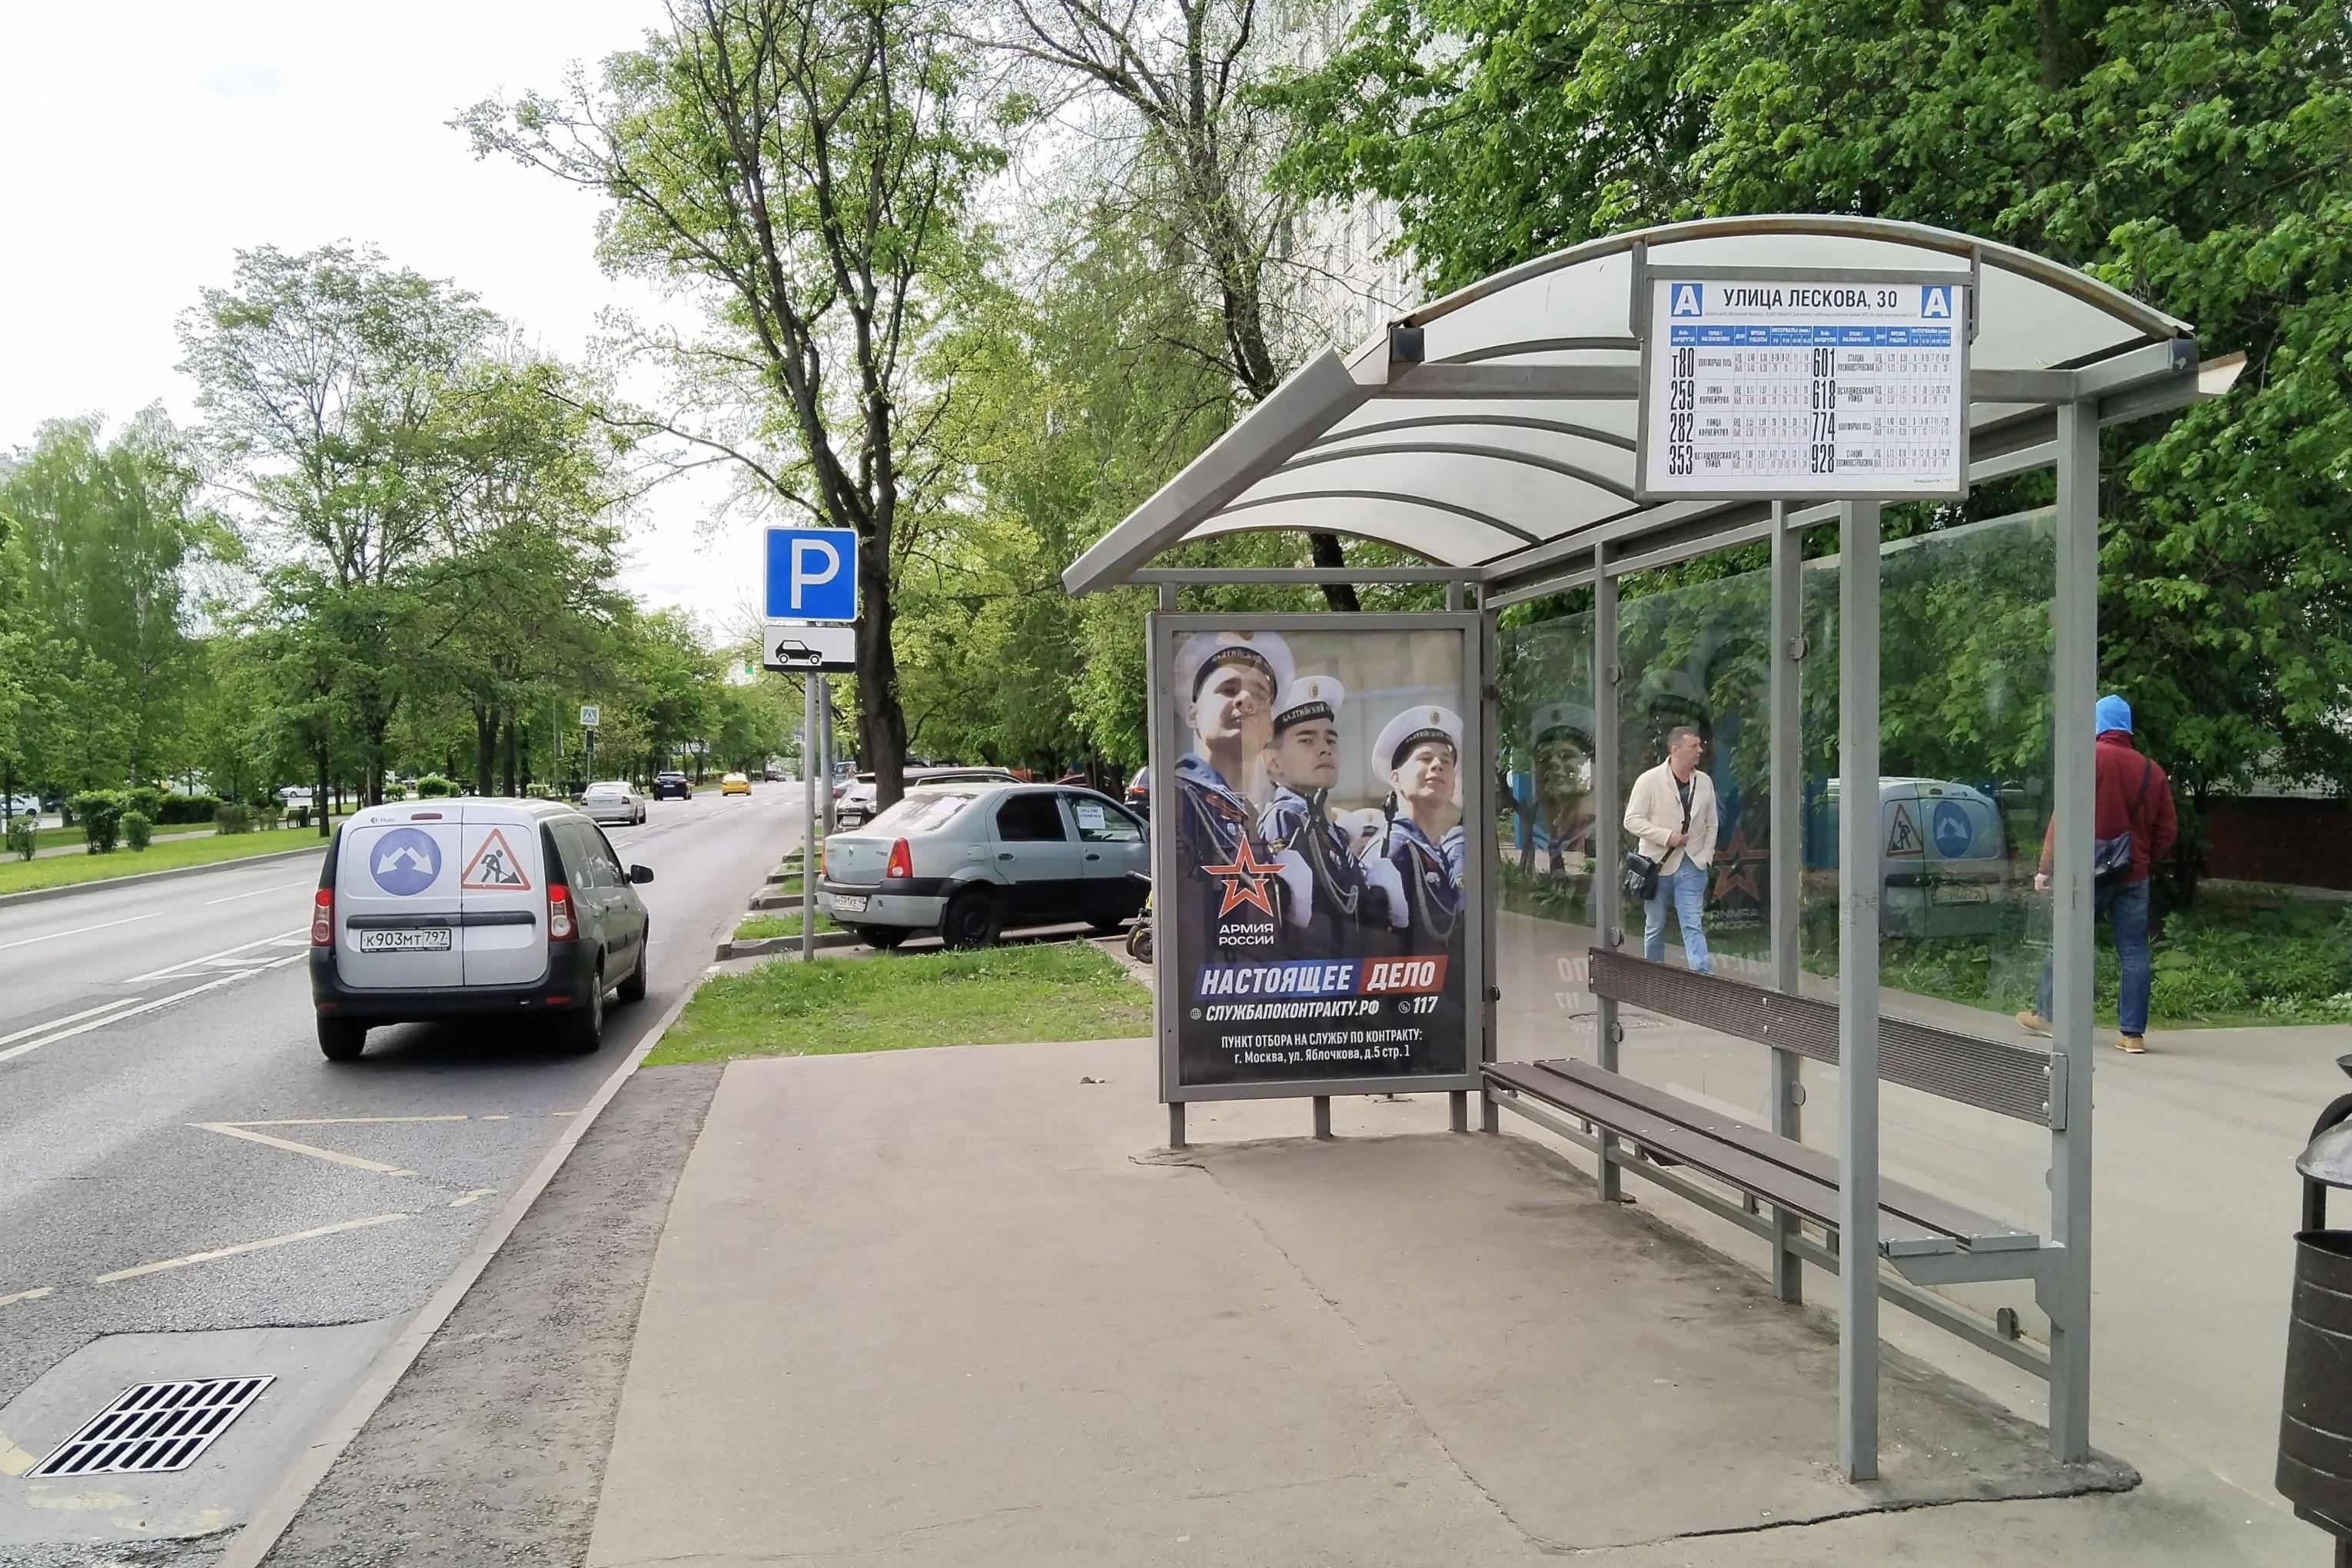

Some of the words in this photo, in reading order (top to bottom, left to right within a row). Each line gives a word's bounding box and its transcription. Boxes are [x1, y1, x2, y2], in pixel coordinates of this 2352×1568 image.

[1673, 286, 1701, 315] А
[1723, 288, 1782, 310] УЛИЦА
[1788, 289, 1871, 310] ЛЕСКОВА,
[1877, 290, 1897, 308] 30
[1923, 287, 1949, 317] А
[1812, 347, 1835, 377] 601
[1670, 380, 1694, 410] 259
[1699, 395, 1729, 404] КОРНЕЙЧУКА
[1706, 386, 1722, 394] УЛИЦА
[1812, 380, 1835, 410] 618
[1848, 394, 1863, 403] УЛИЦА
[1669, 412, 1694, 443] 282
[1699, 427, 1728, 437] КОРНЕЙЧУКА
[1706, 418, 1722, 427] УЛИЦА
[1812, 412, 1835, 442] 774
[1669, 445, 1693, 475] 353
[1705, 460, 1721, 468] УЛИЦА
[1811, 443, 1835, 473] 928
[790, 538, 840, 610] P
[366, 932, 421, 946] К903МТ
[424, 931, 447, 942] 797
[1219, 923, 1274, 934] АРМИЯ
[1219, 935, 1274, 945] РОССИИ
[1201, 965, 1354, 995] НАСТОЯЩЕЕ
[1367, 962, 1437, 992] ДЕЛО
[1206, 1001, 1380, 1022] СЛУЖБАПОКОНТРАКТУ.РФ
[1413, 996, 1438, 1015] 117
[1221, 1036, 1254, 1049] ПУНКТ
[1255, 1035, 1293, 1048] ОТБОРА
[1294, 1035, 1307, 1046] НА
[1309, 1031, 1348, 1046] СЛУЖБУ
[1350, 1031, 1364, 1044] ПО
[1366, 1028, 1423, 1044] КОНТРАКТУ:
[1234, 1055, 1242, 1064] г.
[1244, 1051, 1287, 1064] Москва,
[1288, 1051, 1303, 1065] ул.
[1305, 1048, 1364, 1061] Яблочкова,
[1382, 1046, 1402, 1060] стр.
[1404, 1045, 1410, 1057] 1
